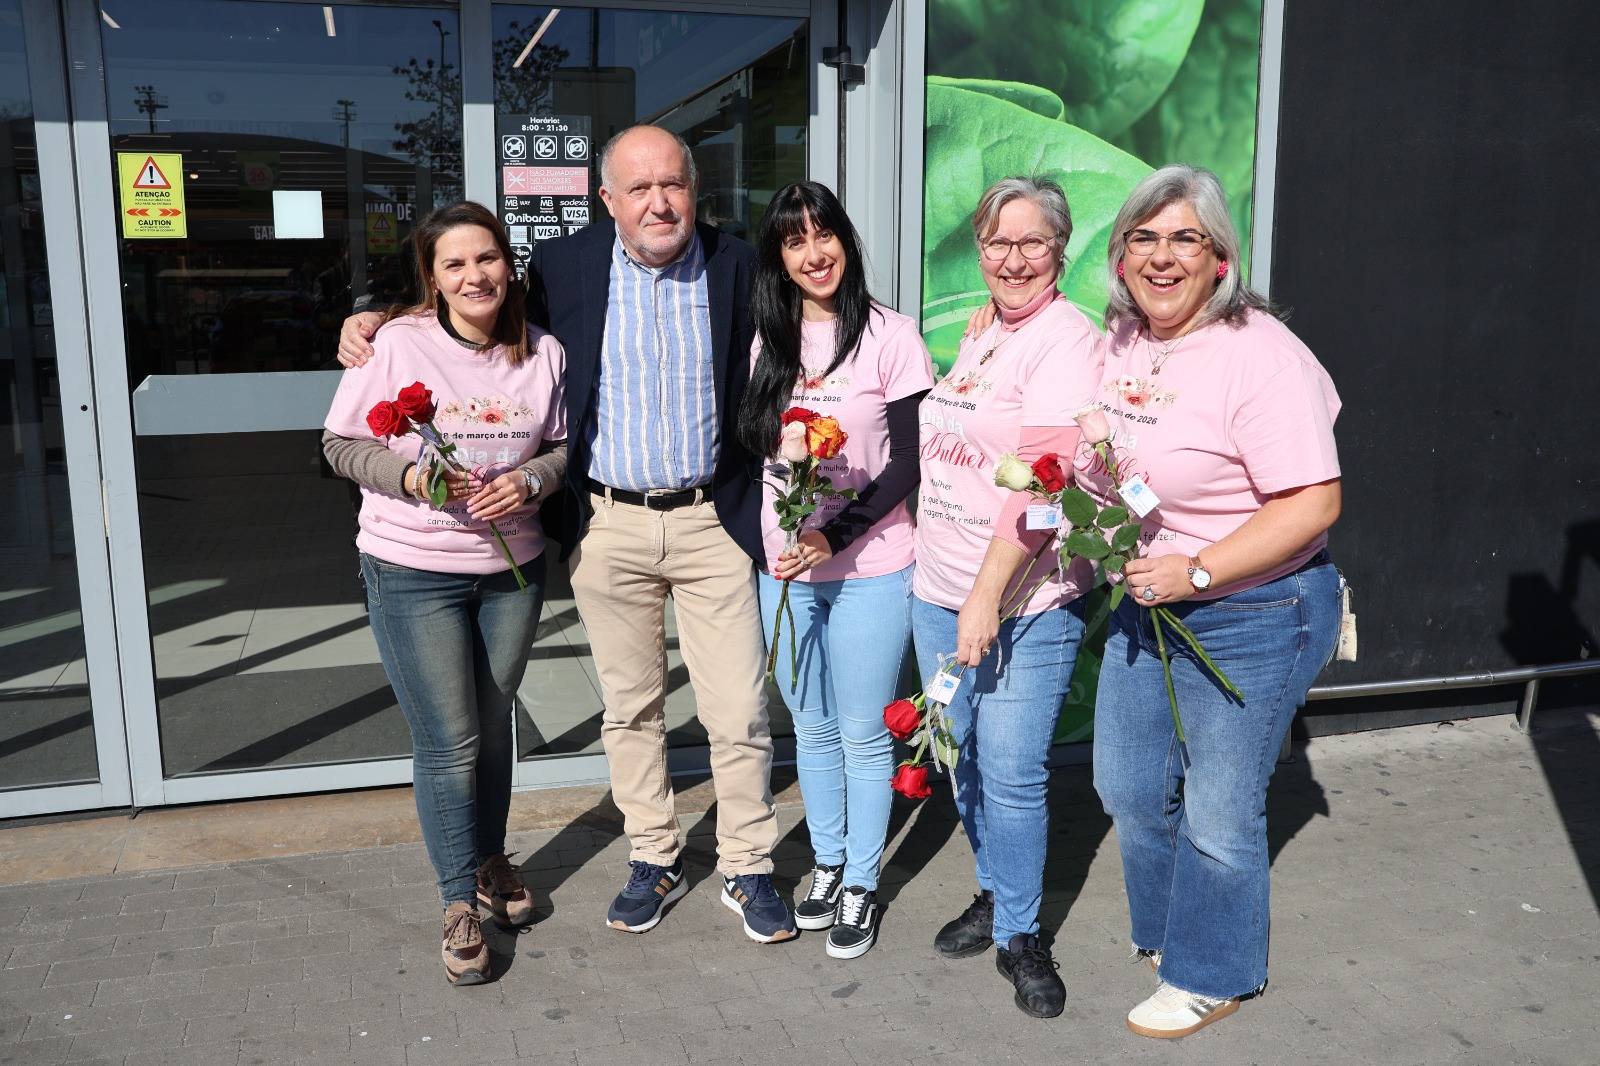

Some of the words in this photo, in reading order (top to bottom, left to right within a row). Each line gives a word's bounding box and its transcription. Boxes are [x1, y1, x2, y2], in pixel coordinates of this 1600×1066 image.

[530, 116, 560, 124] Horário:
[546, 124, 569, 132] 21:30
[504, 199, 518, 207] MB
[539, 199, 554, 207] MB
[565, 209, 588, 218] VISA
[537, 228, 560, 237] VISA
[822, 395, 842, 403] 2026
[959, 401, 977, 411] 2026
[1124, 412, 1136, 421] de
[1136, 415, 1158, 425] 2026
[452, 432, 464, 440] de
[466, 432, 495, 441] março
[497, 431, 509, 439] de
[511, 431, 531, 439] 2026
[427, 518, 461, 529] carrega
[1143, 530, 1177, 542] felizes!
